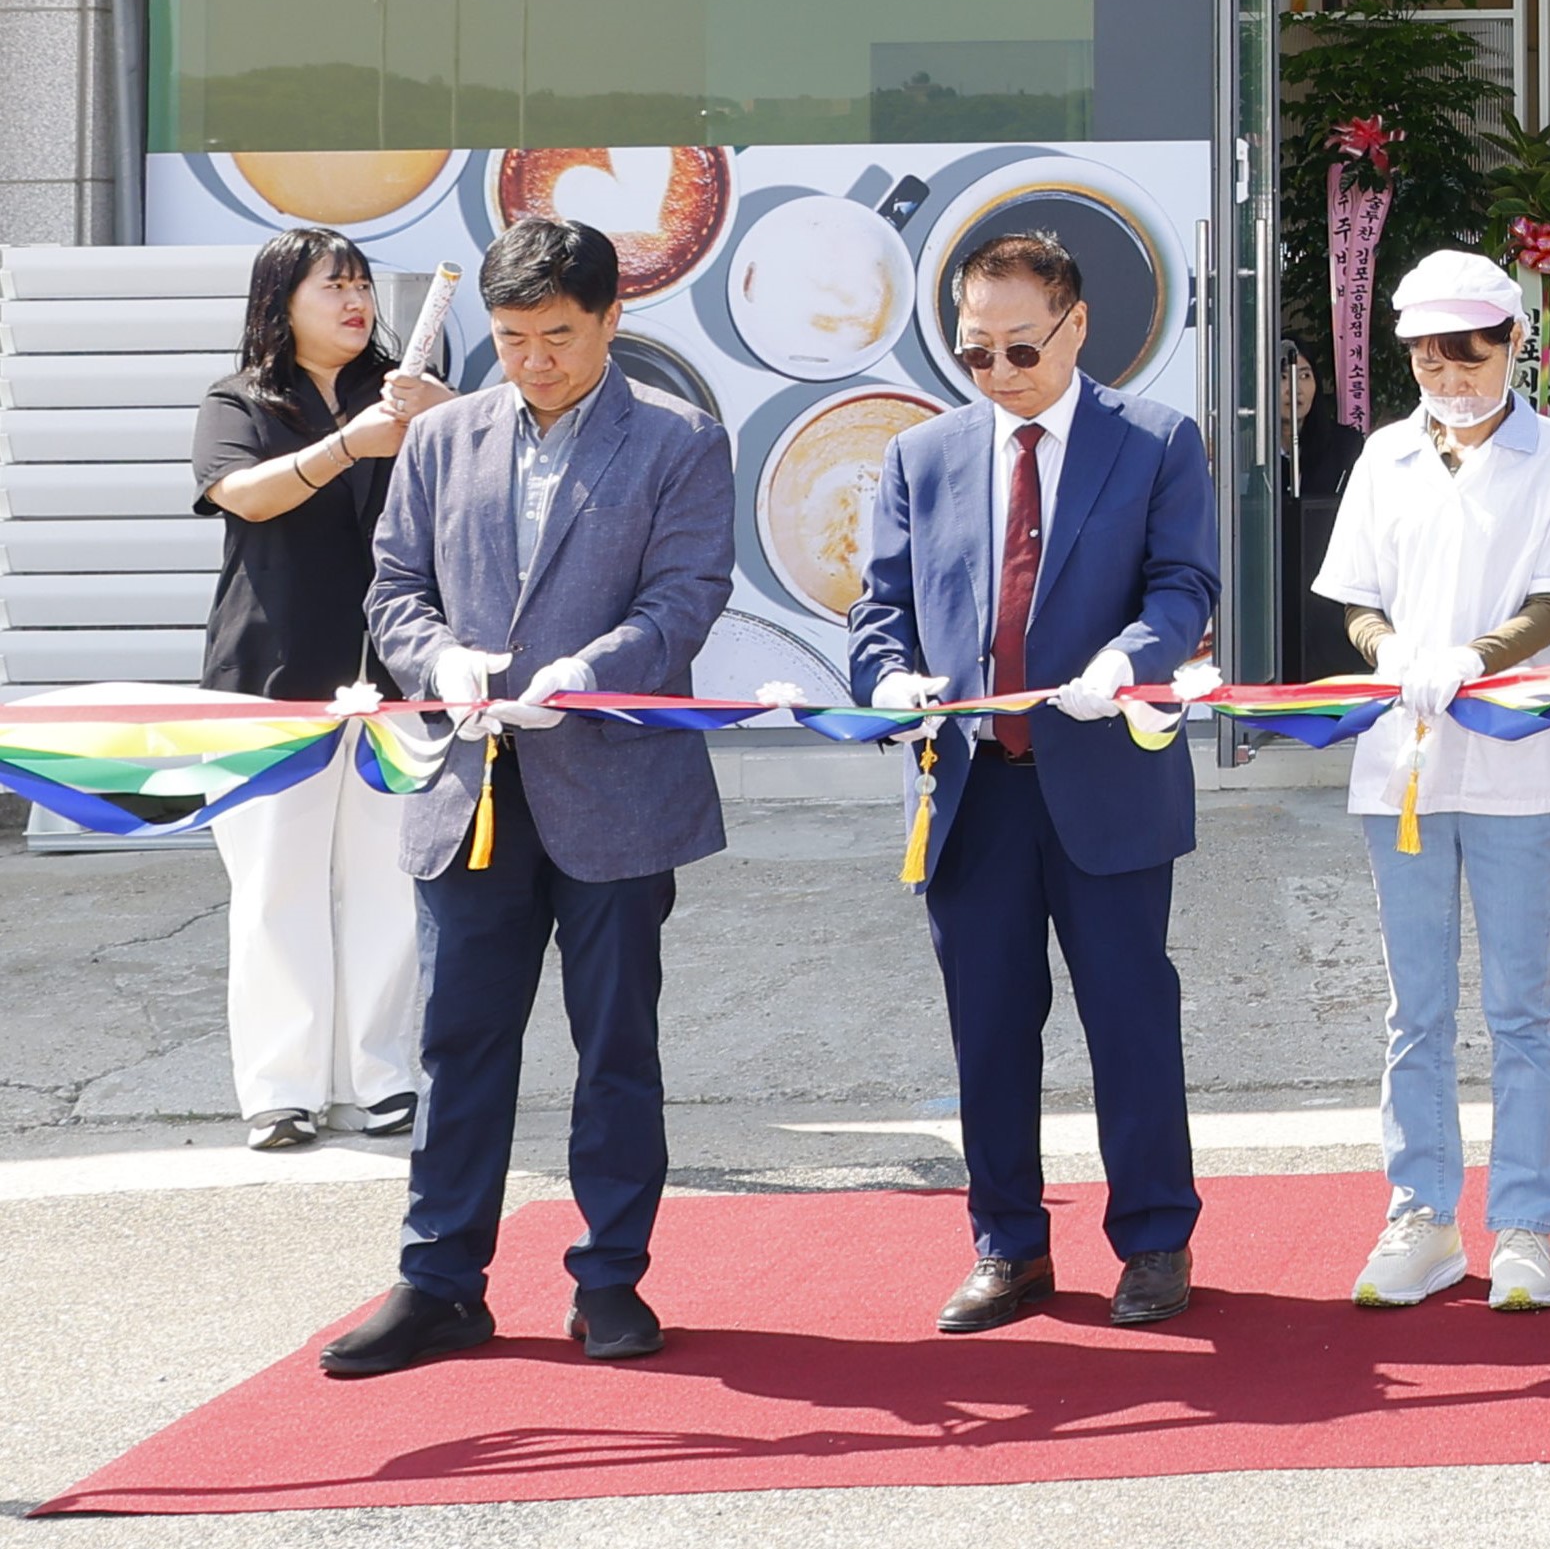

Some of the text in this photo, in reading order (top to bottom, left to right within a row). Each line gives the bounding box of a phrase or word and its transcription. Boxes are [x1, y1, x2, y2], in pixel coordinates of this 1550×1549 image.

[1357, 189, 1386, 242] 술두찬
[1349, 247, 1369, 339] 김포공항점
[1347, 344, 1366, 400] 개소를
